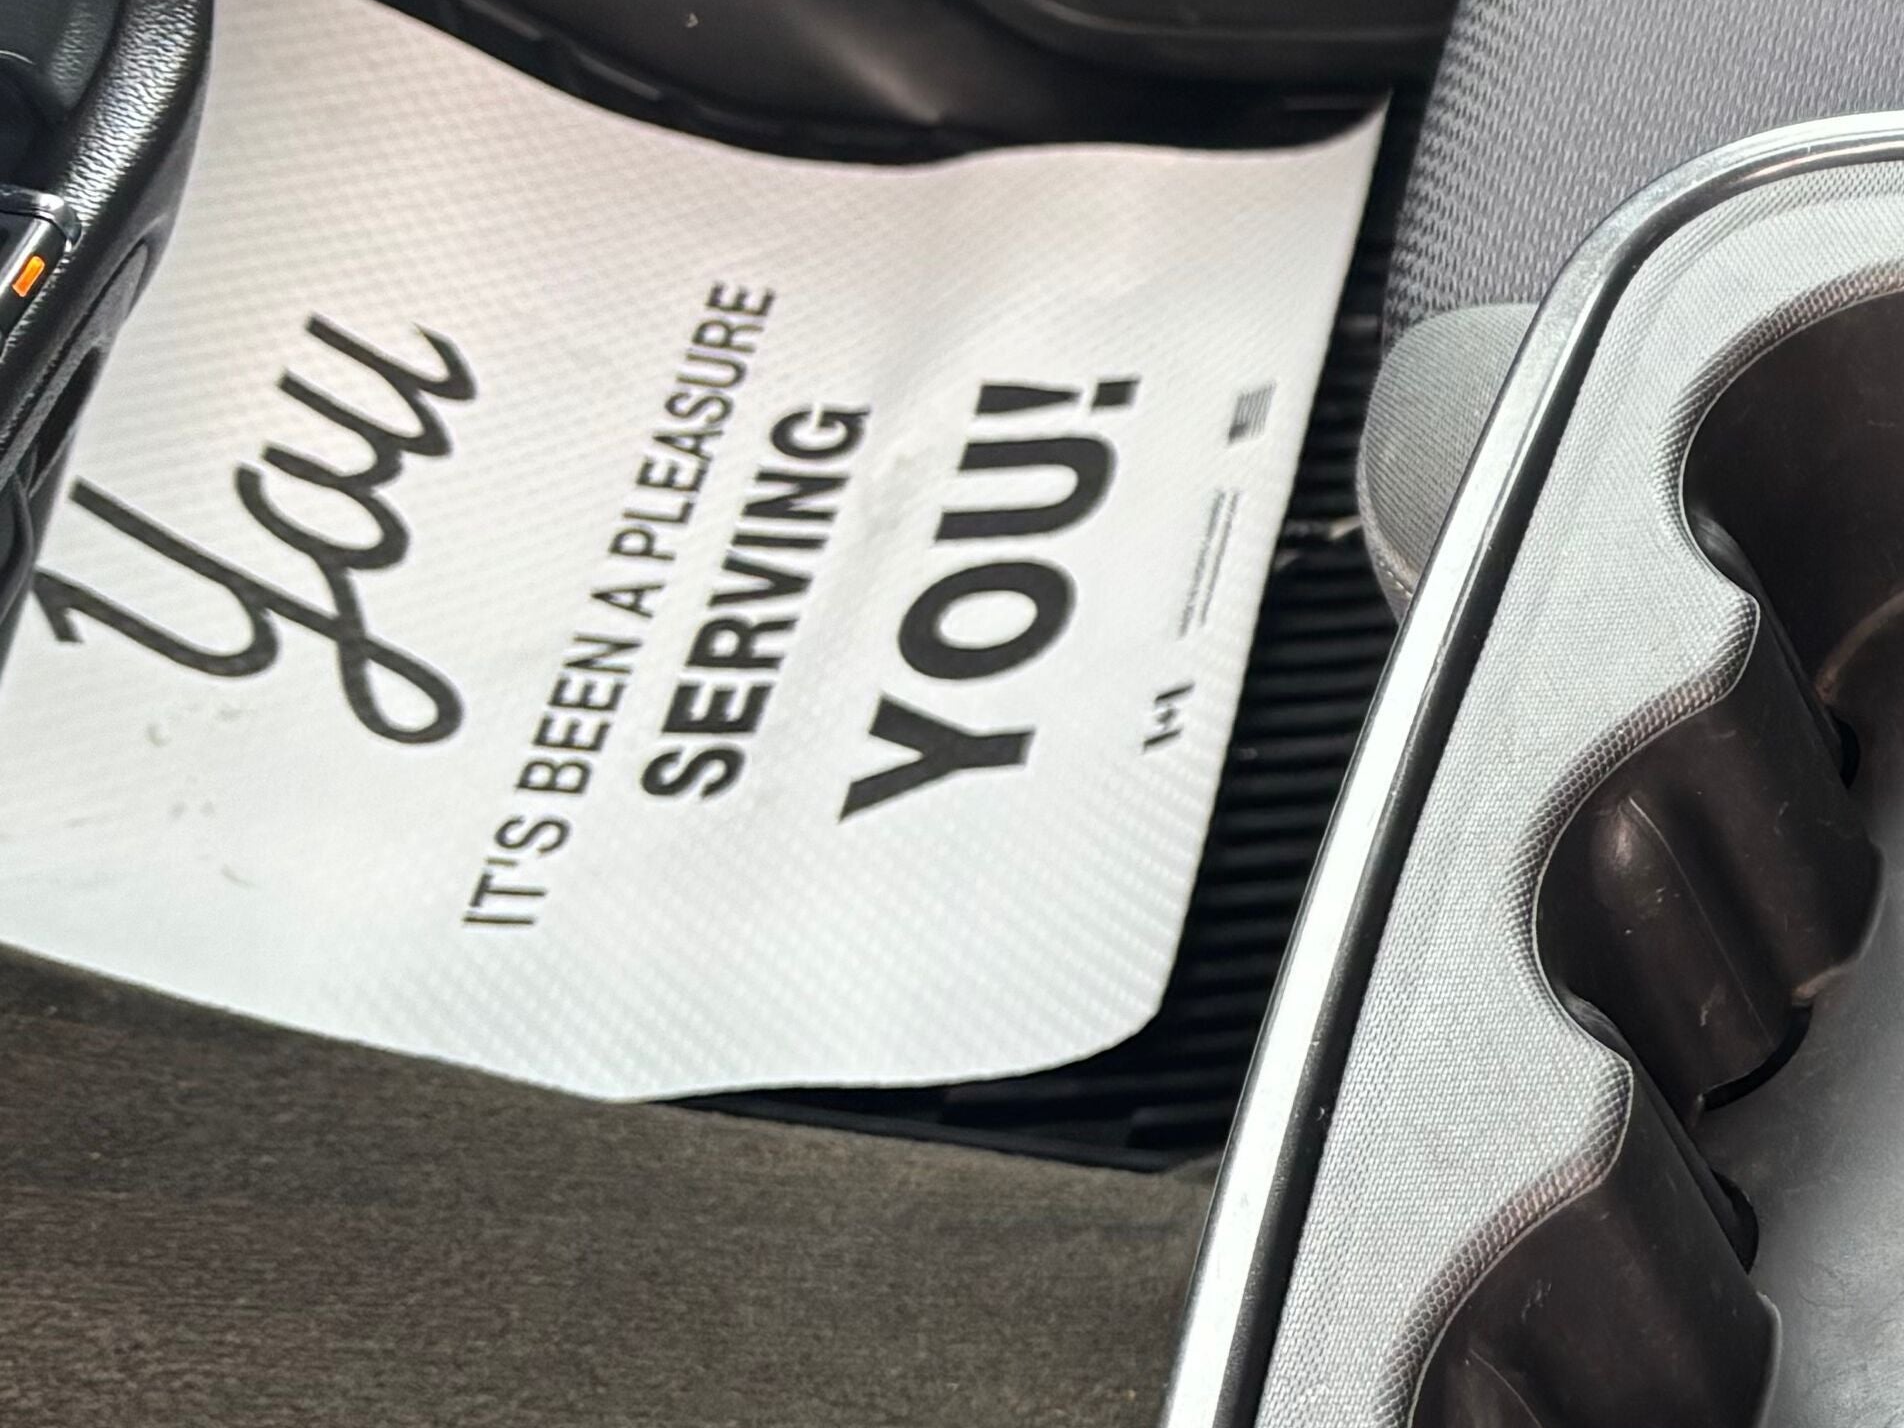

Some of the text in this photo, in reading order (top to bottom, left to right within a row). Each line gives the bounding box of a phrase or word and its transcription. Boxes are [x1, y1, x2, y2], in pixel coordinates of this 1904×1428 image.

[33, 315, 477, 743] You
[463, 282, 775, 925] IT'S BEEN A PLEASURE
[642, 406, 870, 799] SERVING
[839, 378, 1139, 821] YOU!
